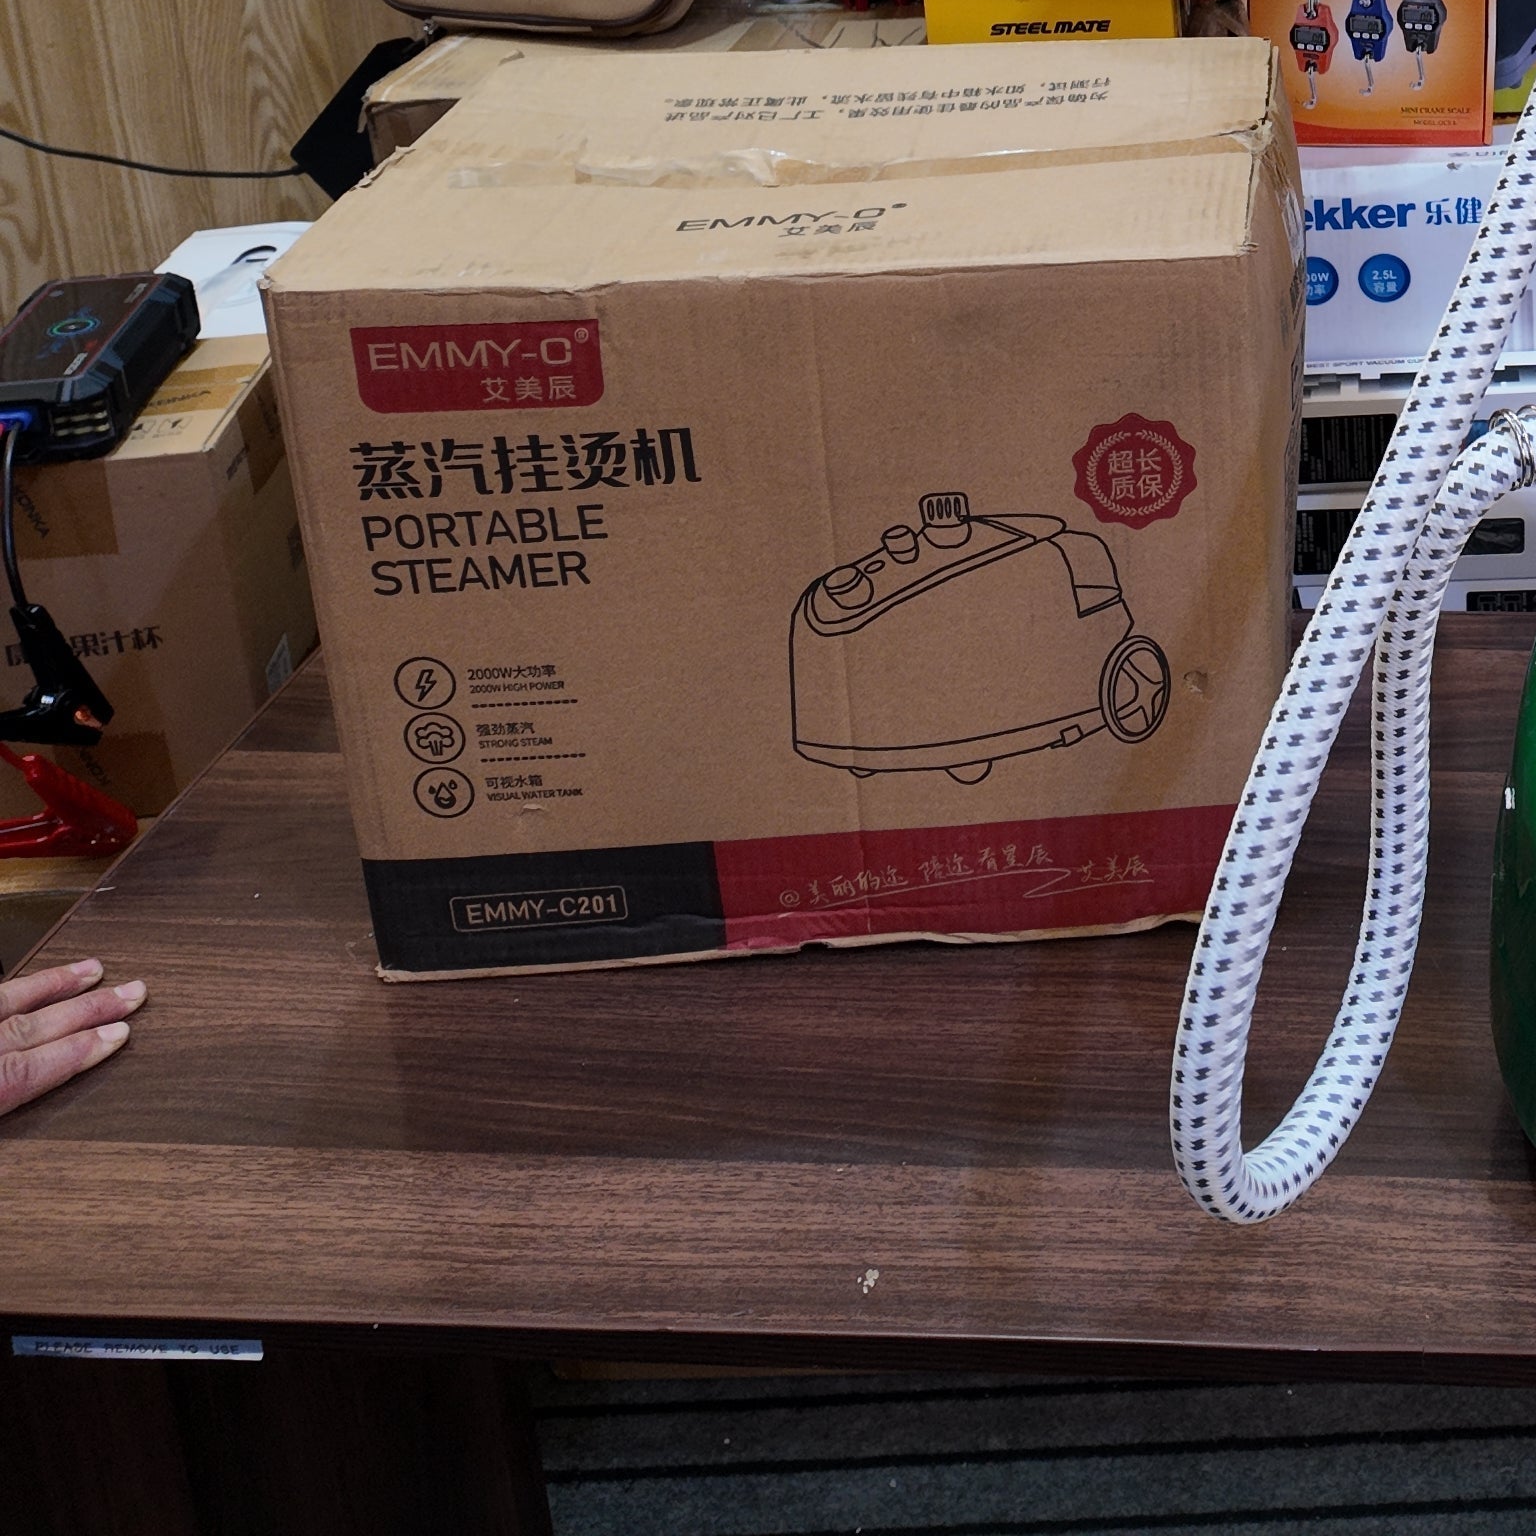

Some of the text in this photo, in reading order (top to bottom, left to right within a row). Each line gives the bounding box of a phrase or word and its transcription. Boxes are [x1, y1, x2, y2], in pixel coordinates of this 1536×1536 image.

[1426, 196, 1483, 226] 乐健
[778, 220, 879, 238] 艾美辰
[1372, 270, 1398, 280] 2.5L
[1372, 281, 1398, 294] 容量
[1306, 362, 1332, 370] BEST
[1333, 360, 1365, 368] SPORT
[1366, 359, 1405, 367] VACUUM
[480, 375, 577, 404] 艾美辰
[350, 427, 702, 501] 蒸汽挂烫机
[1107, 448, 1162, 476] 超长
[1110, 473, 1164, 501] 质保
[360, 504, 609, 552] PORTABLE
[370, 550, 592, 596] STEAMER
[5, 625, 164, 667] 果汁杯
[467, 664, 557, 681] 2000W大功率
[469, 680, 565, 694] 2000W HIGH POWER
[478, 736, 553, 750] STRONG STEAM
[484, 774, 543, 789] 可视水箱
[487, 787, 583, 802] VISUAL WATER TANK
[465, 893, 619, 926] EMMY-C201
[34, 1340, 240, 1355] PLEASE REMOVE TO USE
